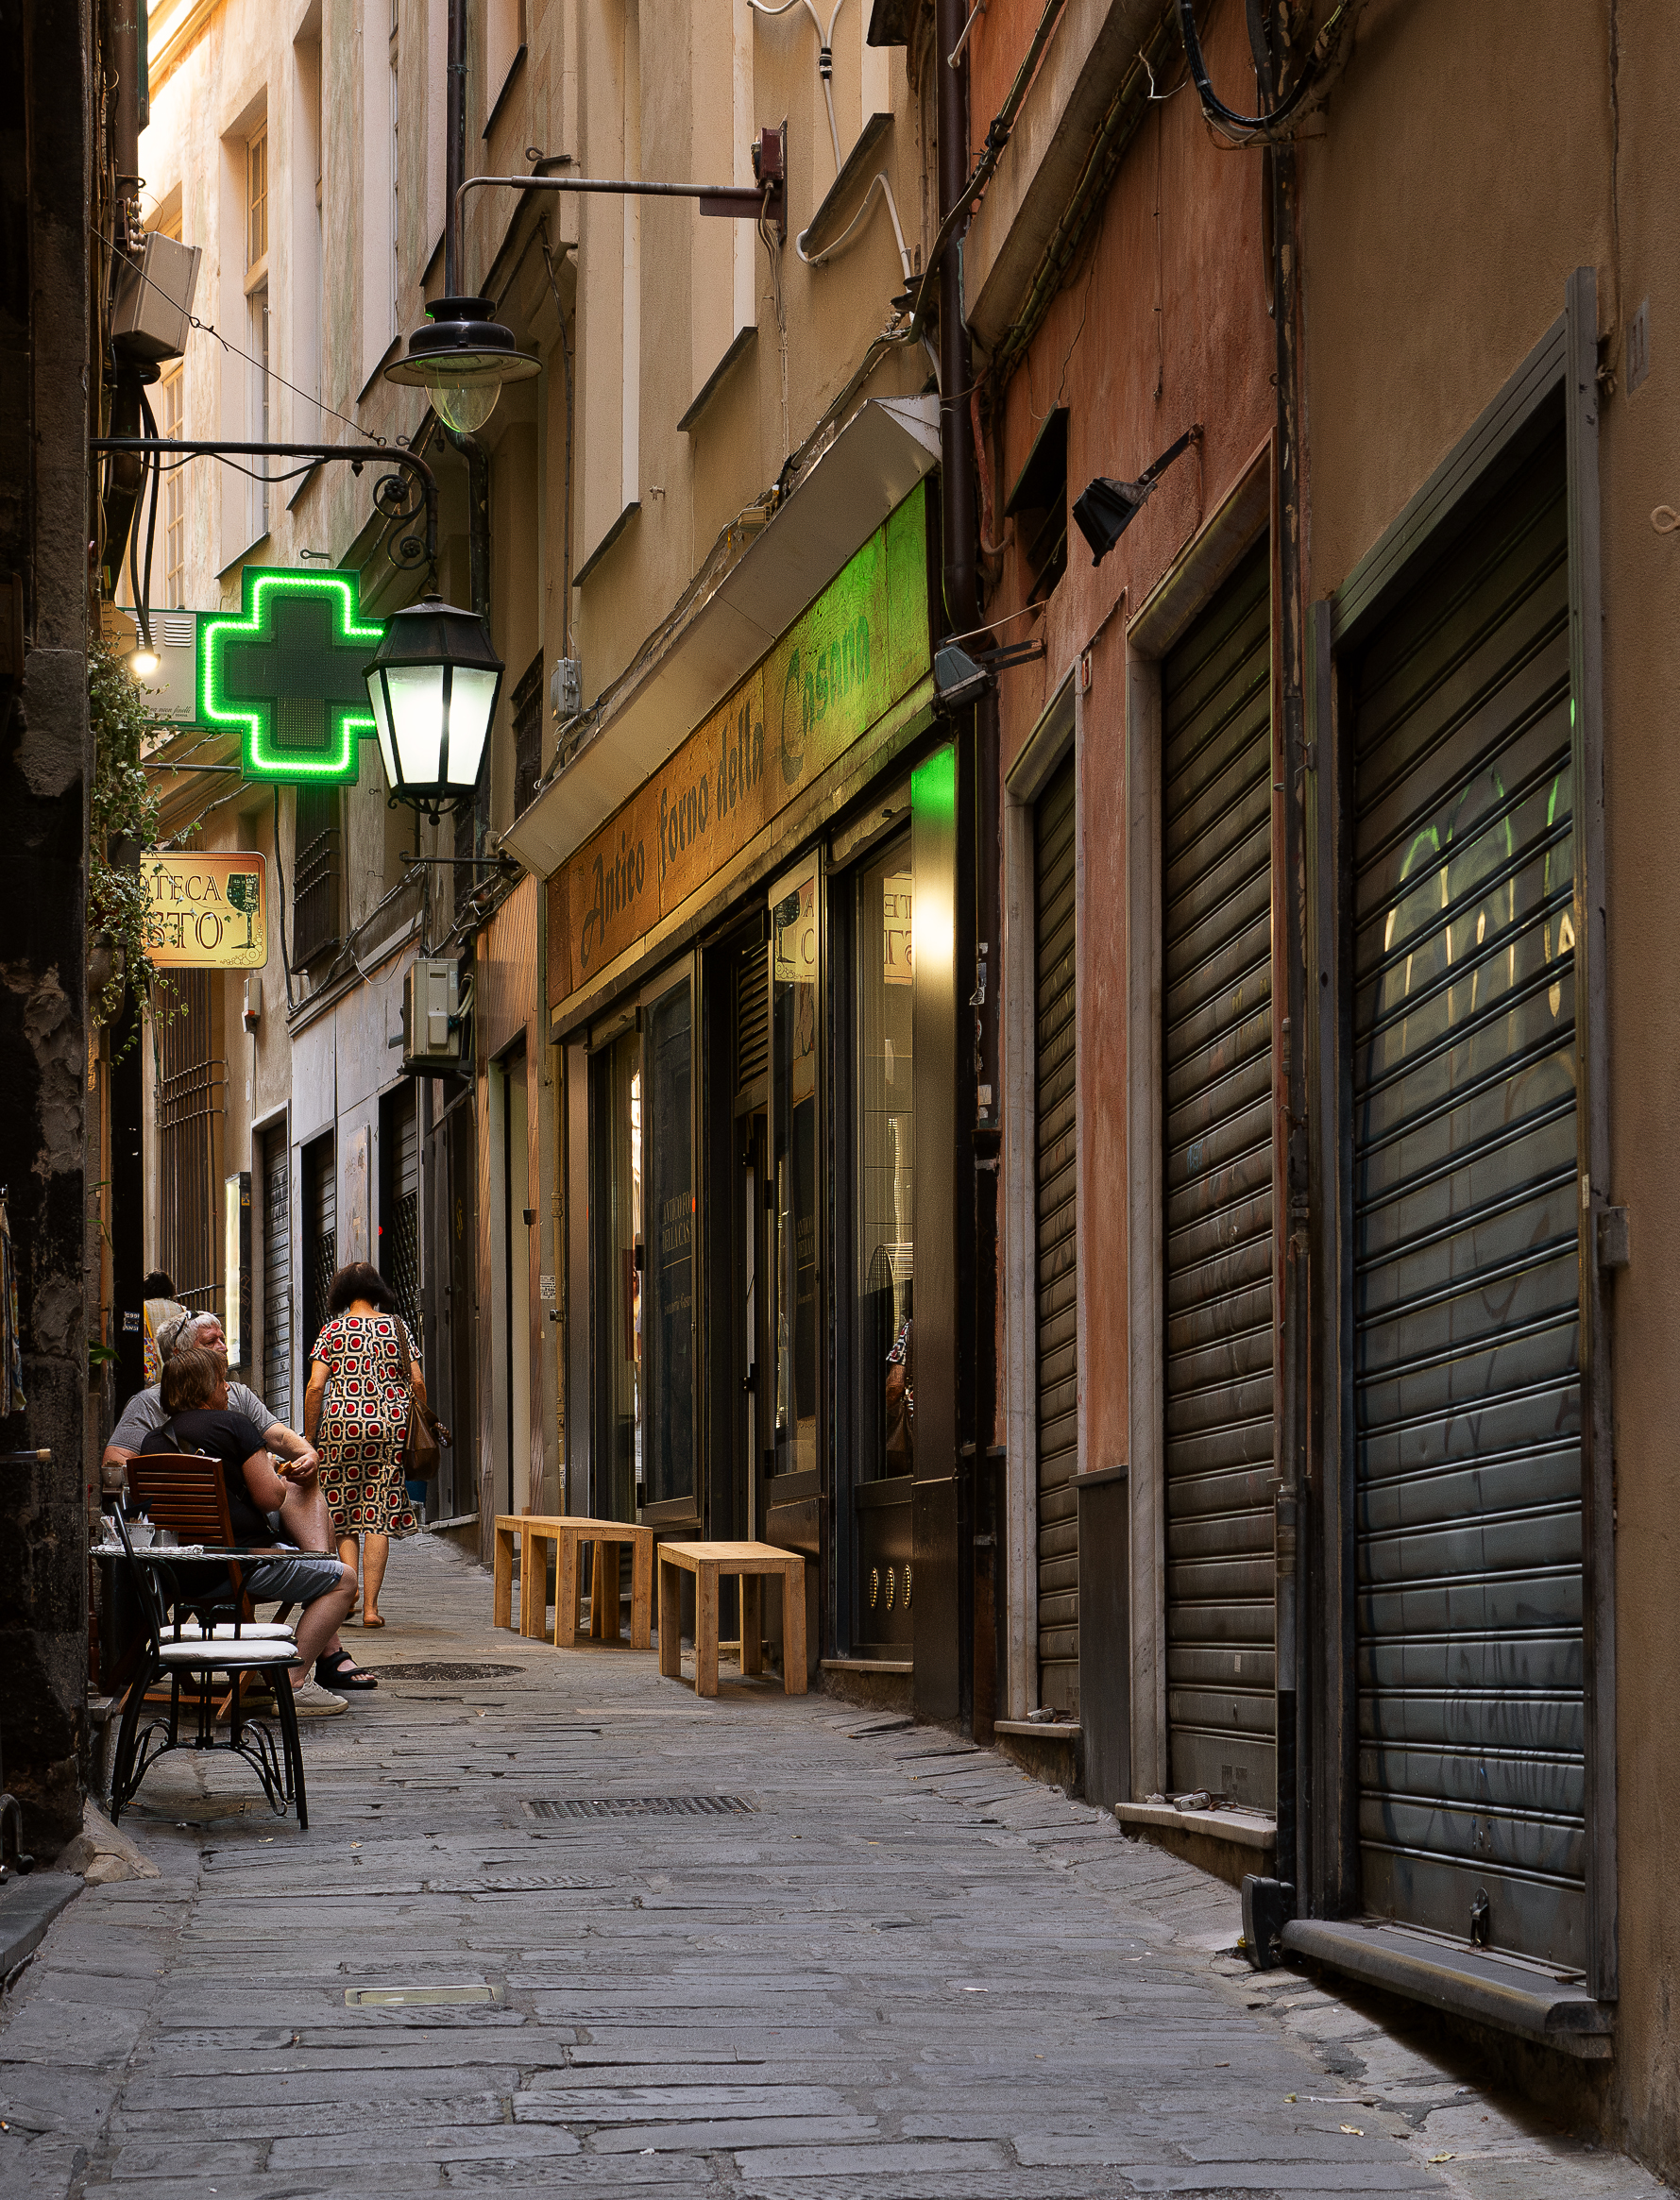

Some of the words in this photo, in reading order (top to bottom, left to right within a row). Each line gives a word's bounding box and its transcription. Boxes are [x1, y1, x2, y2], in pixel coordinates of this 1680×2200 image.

[581, 830, 645, 968] Antico
[661, 772, 708, 882] forno
[717, 699, 764, 822] della
